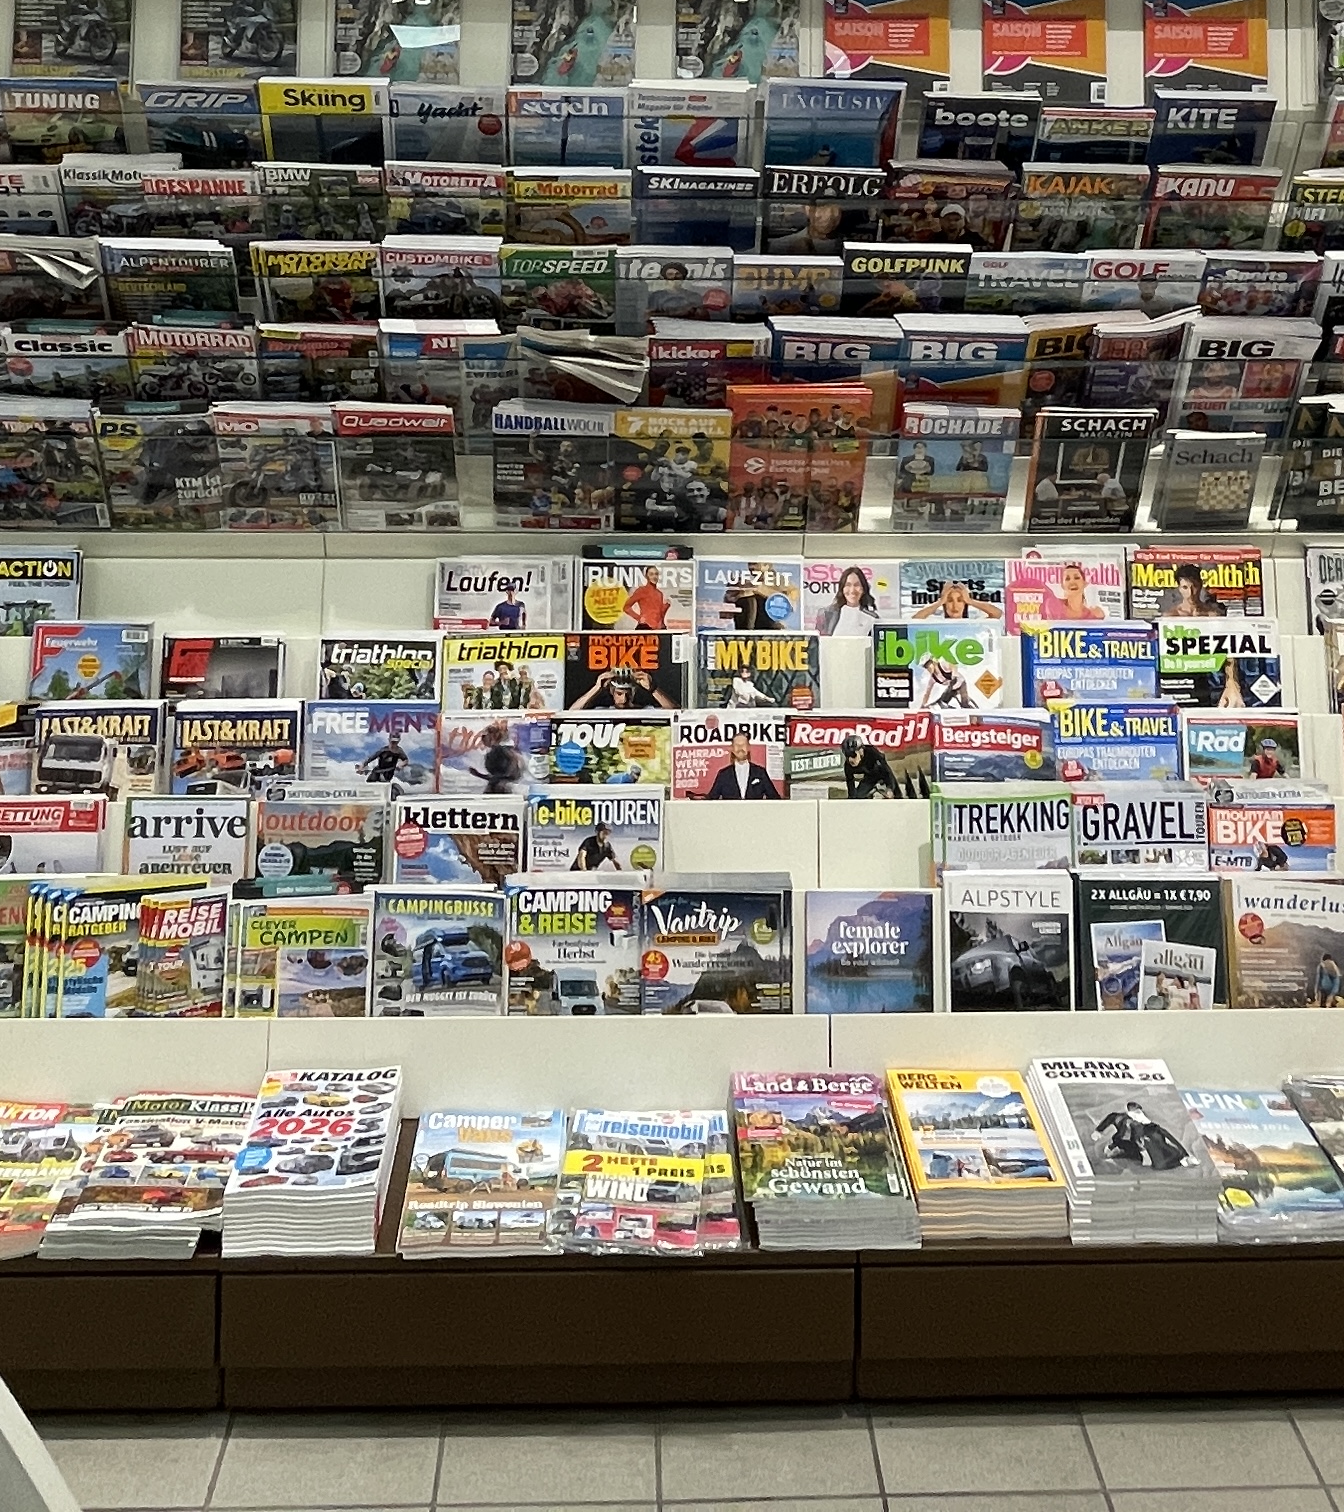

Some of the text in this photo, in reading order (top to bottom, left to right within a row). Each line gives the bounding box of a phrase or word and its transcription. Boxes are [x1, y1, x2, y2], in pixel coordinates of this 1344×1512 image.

[13, 93, 100, 109] TUNING
[144, 92, 247, 107] GRIP
[284, 89, 365, 111] Skiing
[1167, 108, 1238, 128] KITE
[536, 182, 618, 197] Motorrad
[1028, 176, 1109, 195] KAJAK
[1160, 178, 1235, 197] KANU
[385, 252, 484, 265] CUSTOMBIKE
[853, 257, 964, 273] GOLFPUNK
[1094, 261, 1169, 278] GOLF
[15, 341, 112, 352] Classic
[138, 331, 253, 348] MOTORRAD
[657, 346, 720, 359] kicker
[783, 341, 871, 360] BIG
[909, 341, 997, 361] BIG
[1198, 341, 1275, 358] BIG
[100, 421, 137, 438] PS
[343, 414, 449, 429] Quadwelt
[906, 417, 1002, 434] ROCHADE
[1061, 418, 1148, 431] SCHACH
[1176, 449, 1253, 465] Schach
[446, 572, 533, 593] Laufen!
[704, 570, 792, 586] LAUFZEIT
[459, 643, 558, 660] triathlon
[887, 633, 984, 665] bike
[1039, 630, 1155, 660] BIKE & TRAVEL
[1166, 636, 1271, 654] SPEZIAL
[589, 646, 659, 668] BIKE
[715, 640, 808, 670] MY BIKE
[1060, 710, 1176, 738] BIKE & TRAVEL
[680, 724, 785, 742] ROADBIKE
[943, 727, 1038, 747] Bergsteiger
[1198, 732, 1244, 752] Rad
[675, 750, 729, 760] FAHRRAD-
[676, 759, 710, 770] WERK-
[676, 770, 708, 778] STATT
[404, 808, 519, 830] klettern
[956, 799, 1069, 833] TREKKING
[1083, 802, 1193, 841] GRAVEL
[1196, 802, 1205, 839] TOUREN
[127, 815, 246, 839] arrive
[1216, 820, 1281, 842] BIKE
[519, 891, 612, 912] CAMPING
[962, 891, 1061, 907] ALPSTYLE
[1092, 890, 1107, 901] 2X
[1110, 888, 1151, 902] ALLGÄU
[1164, 890, 1178, 901] 1X
[165, 905, 222, 921] REISE
[388, 900, 494, 917] CAMPINGBUSSE
[161, 919, 220, 937] MOBIL
[252, 921, 297, 930] CLEVER
[520, 915, 596, 934] & REISE
[654, 903, 741, 939] Vantrip
[261, 929, 348, 946] CAMPEN
[839, 923, 900, 939] female
[832, 938, 909, 958] explorer
[1040, 1061, 1130, 1071] MILANO
[299, 1069, 397, 1082] KATALOG
[897, 1074, 937, 1083] BERG
[1045, 1069, 1165, 1082] CORTINA 26
[742, 1076, 874, 1093] Land & Berge
[900, 1081, 961, 1089] WELTEN
[133, 1099, 253, 1113] Motor Klassik
[261, 1108, 355, 1119] Alle Autos
[250, 1119, 354, 1136] 2026
[601, 1118, 704, 1139] reisemobil
[582, 1155, 658, 1172] 2 HEFTE
[634, 1167, 696, 1178] 1 PREIS
[771, 1166, 860, 1181] schönsten
[769, 1178, 867, 1194] Gewand
